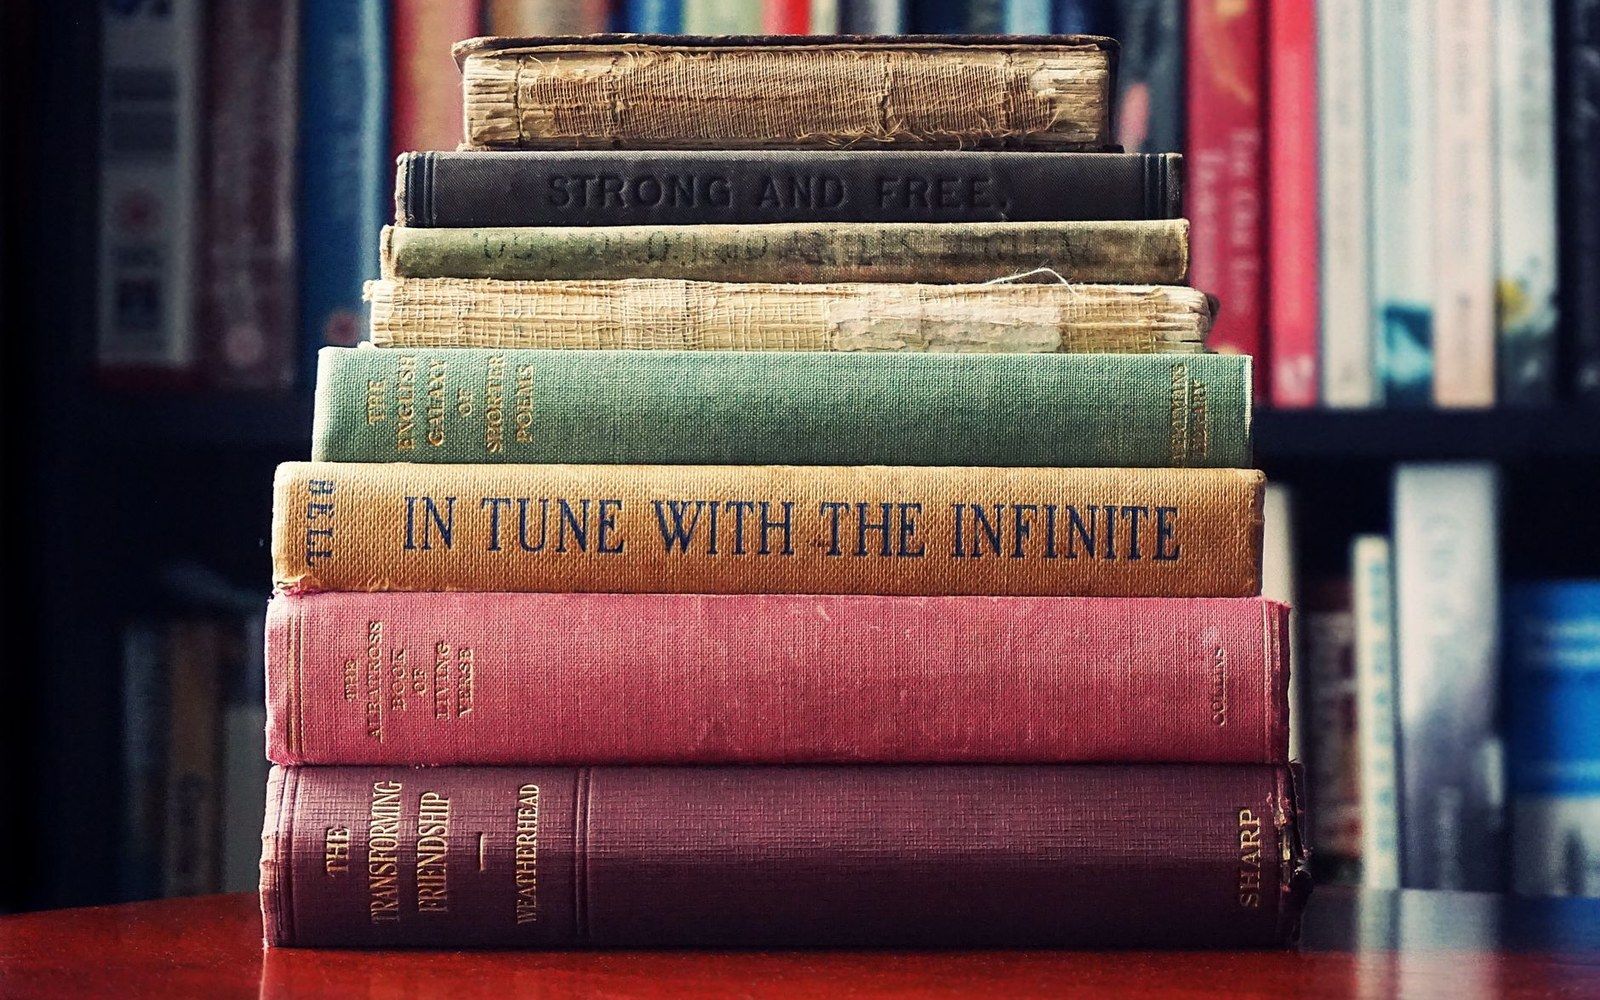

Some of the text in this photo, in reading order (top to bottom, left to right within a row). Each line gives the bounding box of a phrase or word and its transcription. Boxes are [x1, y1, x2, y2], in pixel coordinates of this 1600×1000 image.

[547, 174, 736, 211] STRONG
[758, 175, 848, 211] AND
[367, 380, 386, 425] THE
[396, 354, 416, 452] ENGLISH
[427, 359, 446, 448] GALAXY
[457, 387, 473, 418] OF
[485, 354, 504, 454] SHORTER
[515, 365, 533, 444] POEMS
[307, 479, 335, 567] BELL
[404, 495, 1181, 562] IN TUNE WITH THE INFINITE
[367, 620, 383, 743] ALBATROSS
[389, 647, 406, 712] BOOK
[411, 667, 427, 695] OF
[434, 640, 451, 720] LIVING
[457, 646, 473, 718] VERSE
[325, 826, 350, 877] THE
[368, 780, 403, 924] TRANSFORMING
[416, 791, 450, 914] FRIENDSHIP
[515, 783, 540, 926] WEATHERHEAD
[1239, 808, 1261, 908] SHARP
